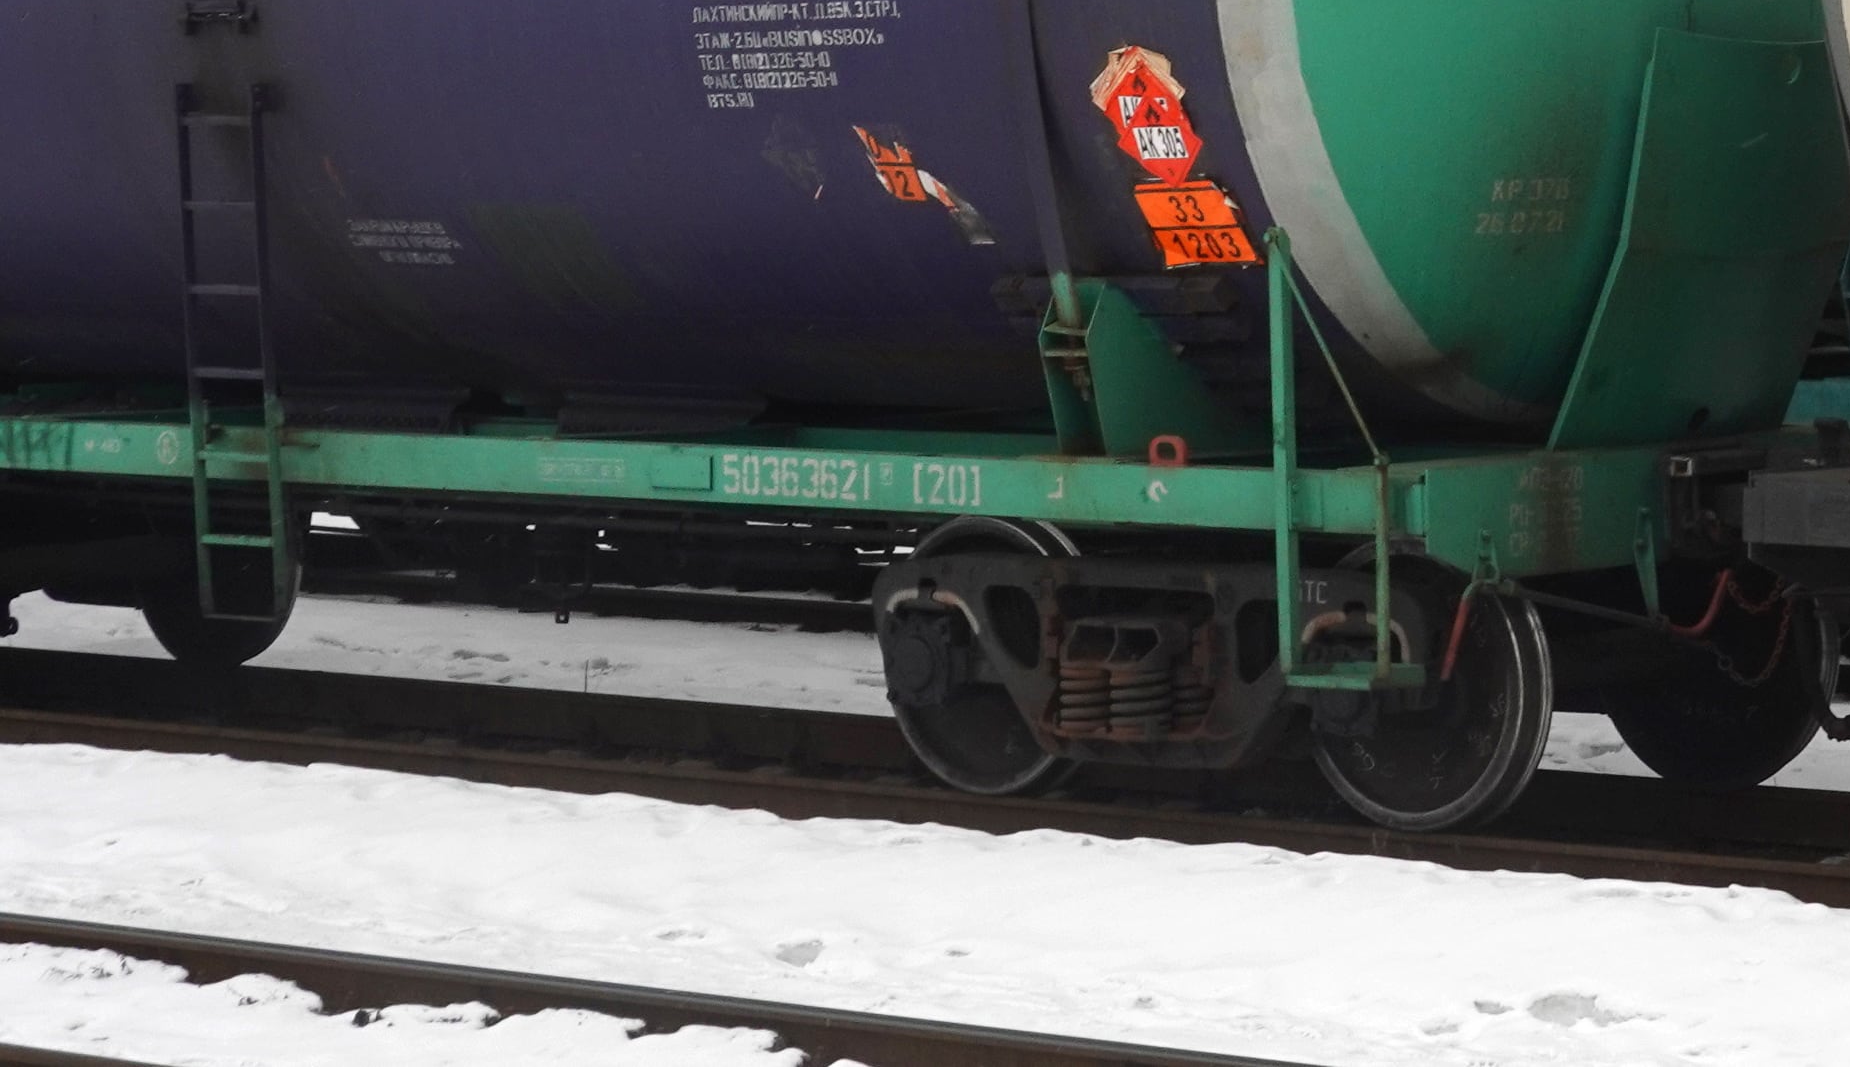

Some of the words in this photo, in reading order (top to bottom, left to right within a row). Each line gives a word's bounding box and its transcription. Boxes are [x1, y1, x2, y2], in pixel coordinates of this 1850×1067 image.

[1157, 127, 1187, 158] 305
[1168, 195, 1206, 223] 33
[1171, 231, 1242, 259] 1203
[722, 453, 871, 502] 50363621
